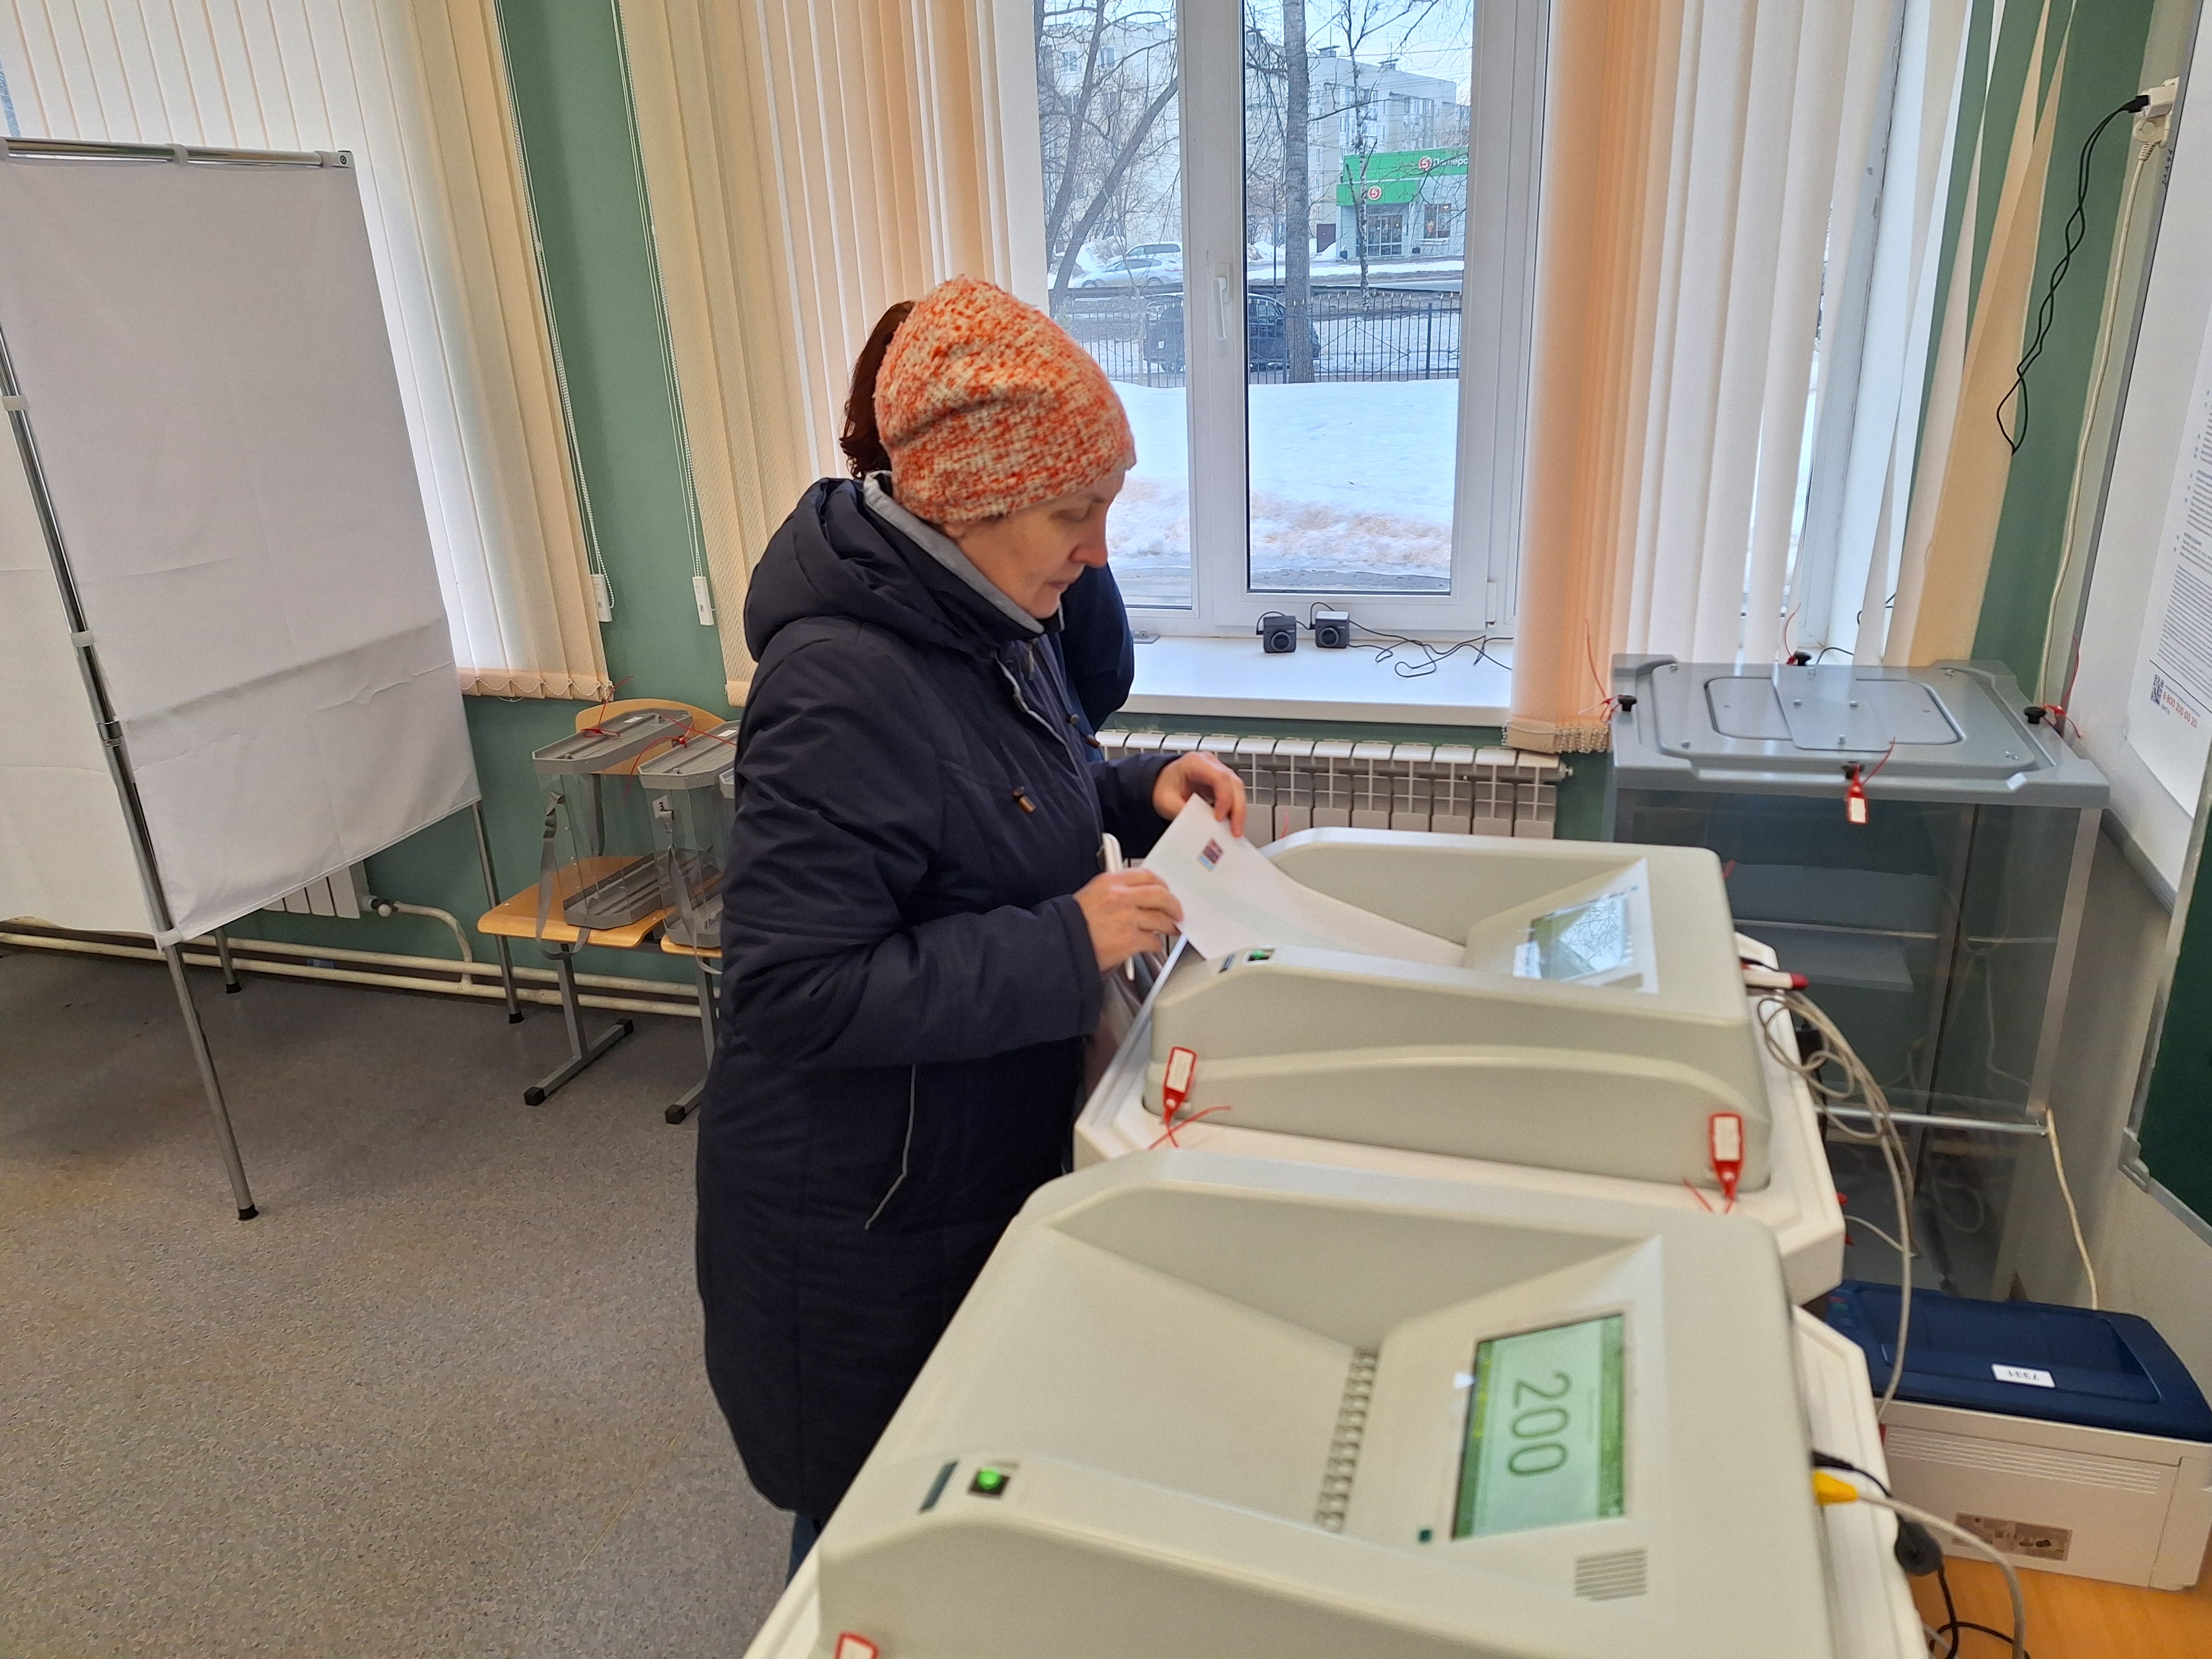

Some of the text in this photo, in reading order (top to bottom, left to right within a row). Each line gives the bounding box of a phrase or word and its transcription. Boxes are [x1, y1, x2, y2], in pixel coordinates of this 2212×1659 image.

[2176, 702, 2184, 716] 200
[2184, 711, 2191, 722] 00
[2191, 717, 2197, 728] 20
[658, 801, 664, 812] 3
[1508, 1371, 1571, 1477] 200
